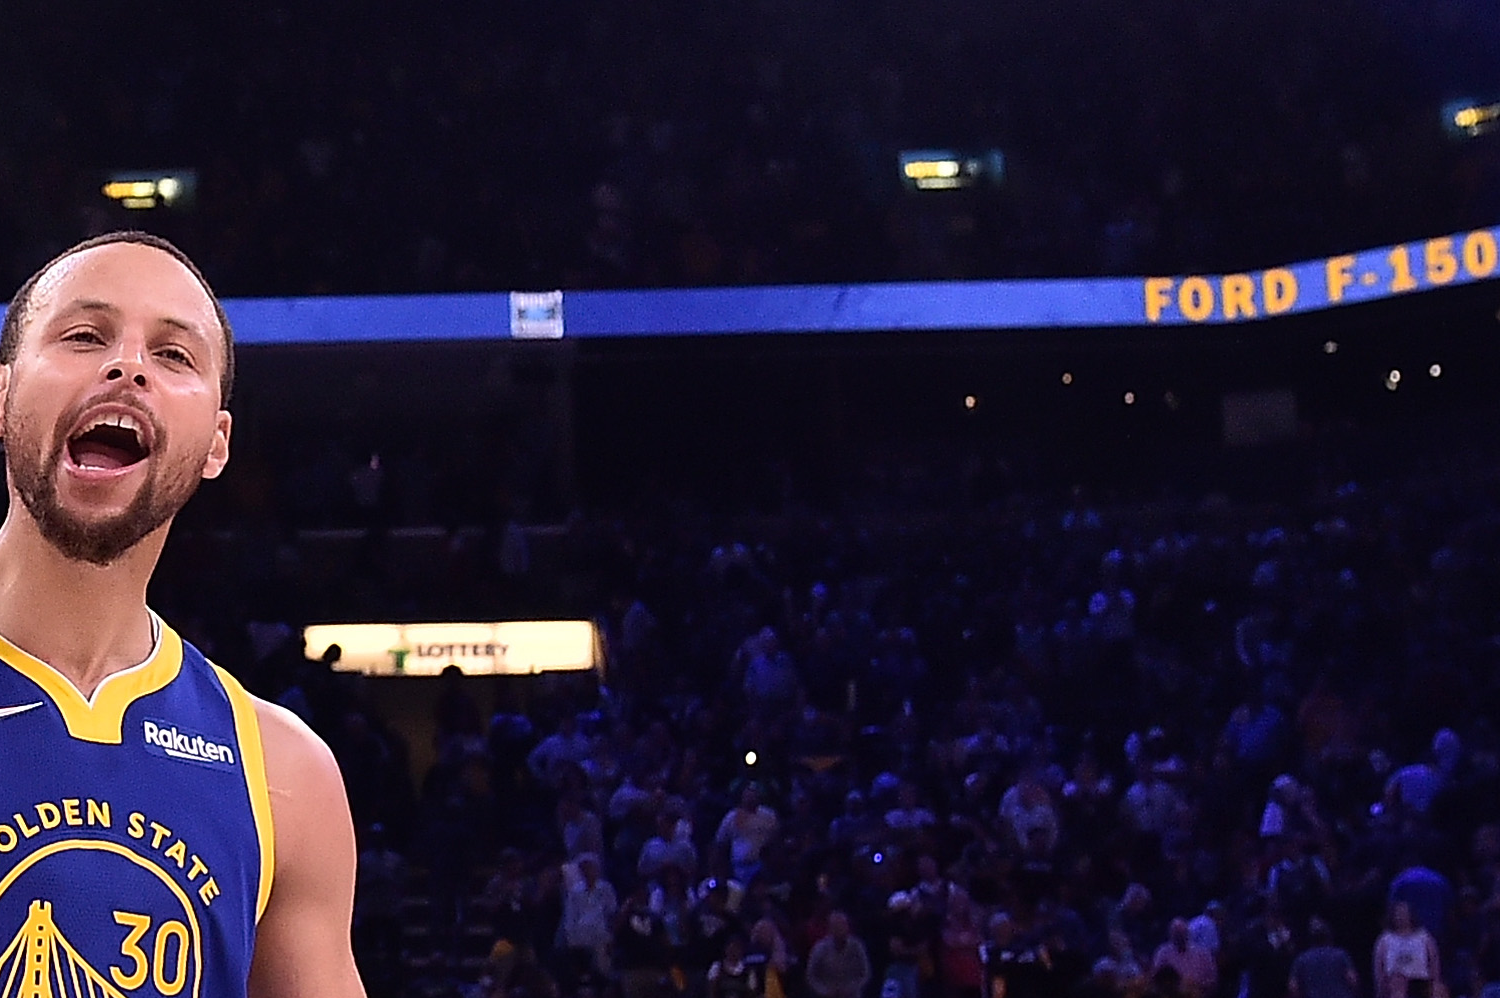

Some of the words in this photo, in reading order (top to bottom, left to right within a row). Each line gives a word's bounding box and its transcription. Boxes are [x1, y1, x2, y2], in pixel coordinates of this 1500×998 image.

[1144, 268, 1298, 323] FORD
[1326, 229, 1499, 304] F-150
[143, 721, 235, 765] Rakuten
[127, 812, 221, 906] STATE
[110, 909, 190, 996] 30
